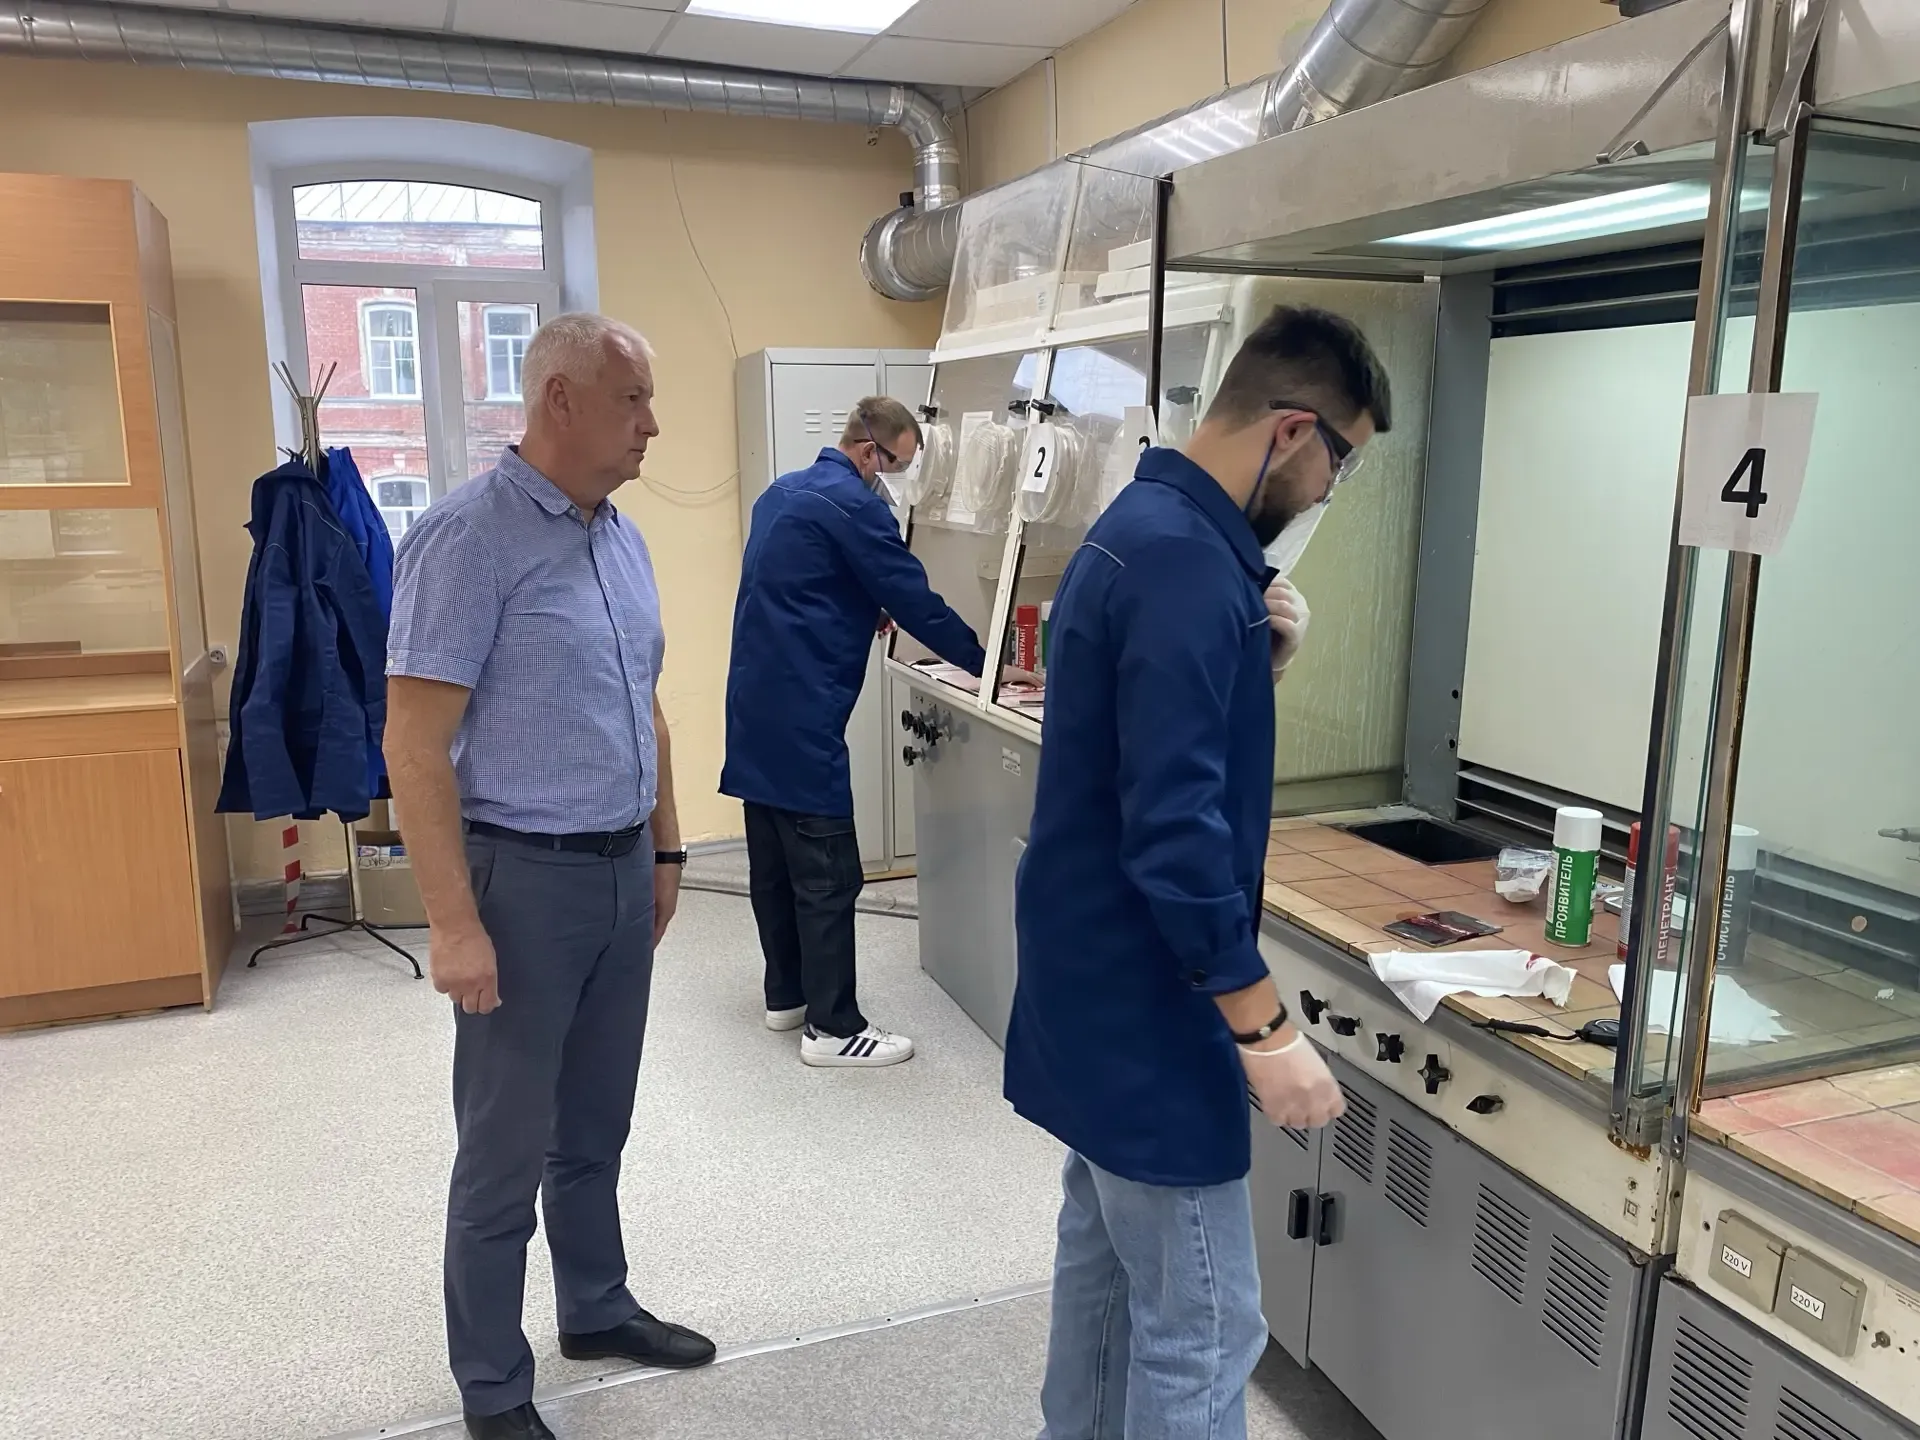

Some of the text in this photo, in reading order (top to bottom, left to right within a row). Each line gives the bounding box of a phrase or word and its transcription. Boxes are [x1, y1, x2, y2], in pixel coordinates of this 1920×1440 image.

[1034, 446, 1046, 478] 2
[1721, 448, 1767, 518] 4
[1554, 855, 1574, 939] ПРОЯВИТЕЛЬ
[1657, 874, 1676, 960] ПЕНЕТРАНТ
[1724, 1251, 1748, 1271] 220 V
[1792, 1291, 1820, 1313] 220 V
